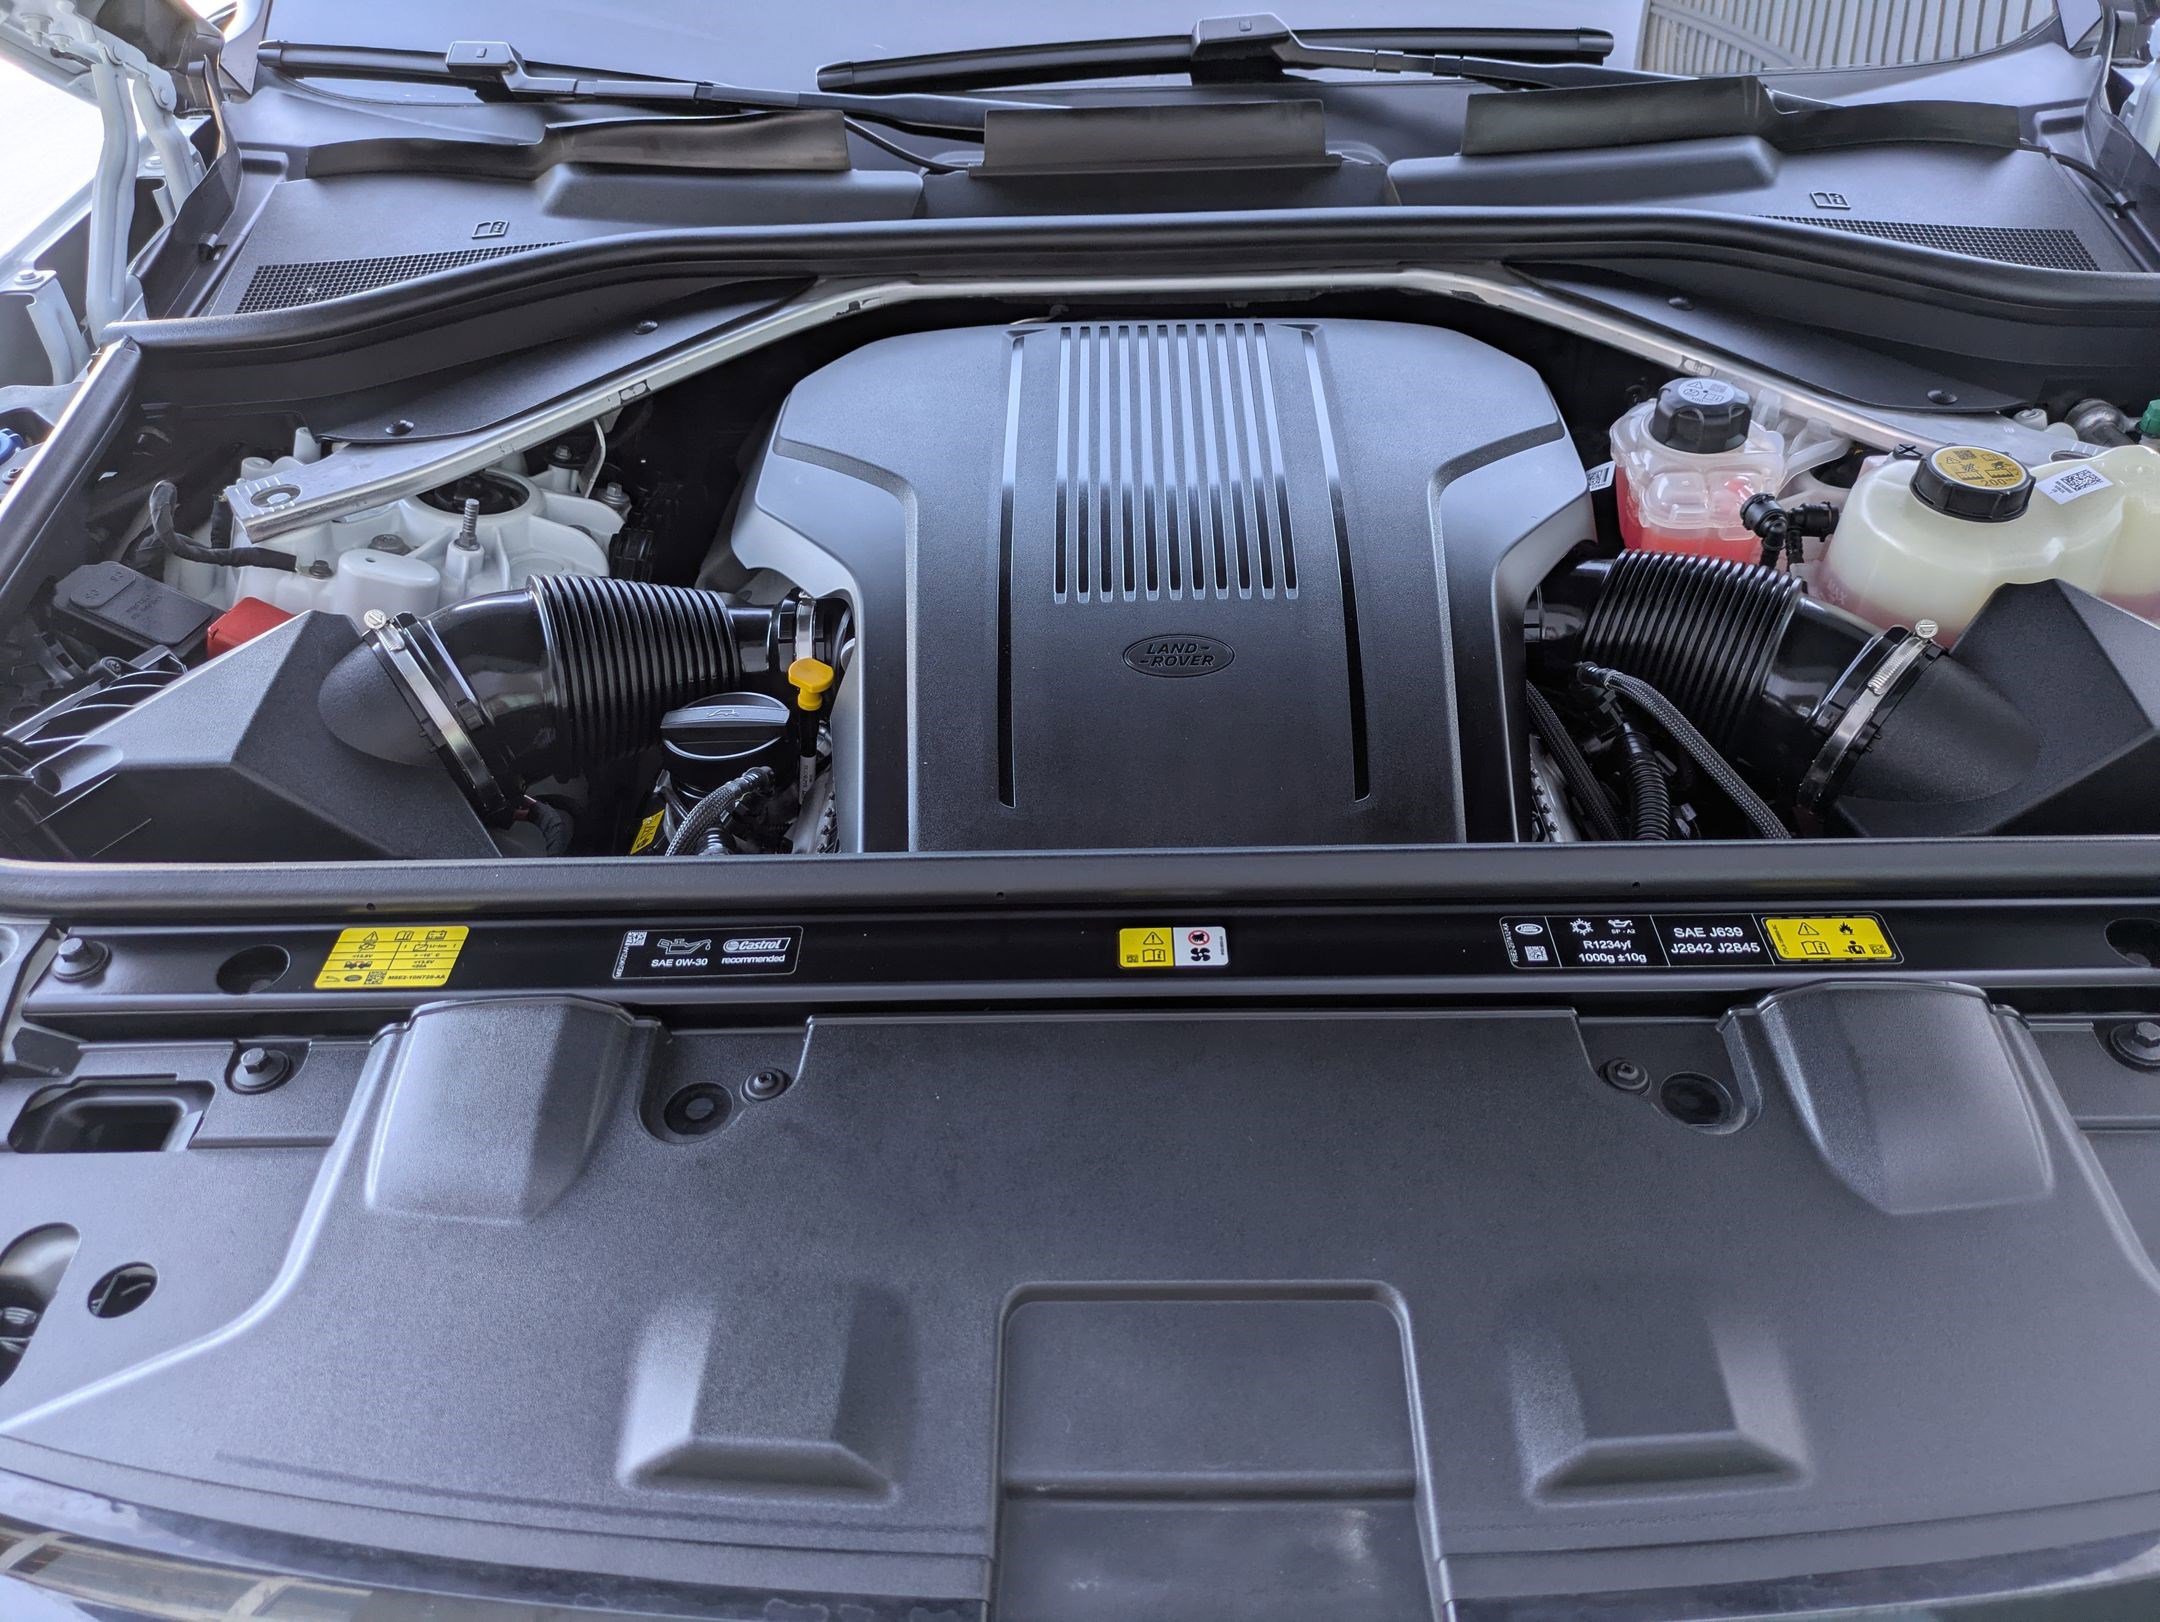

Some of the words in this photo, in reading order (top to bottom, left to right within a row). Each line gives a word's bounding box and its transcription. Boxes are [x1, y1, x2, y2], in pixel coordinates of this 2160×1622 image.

[1673, 927, 1706, 938] SAE
[1709, 926, 1744, 937] J639
[738, 939, 782, 950] Castrol
[1582, 939, 1632, 951] R1234yf
[1670, 943, 1715, 954] J2842
[1717, 942, 1761, 953] J2845
[650, 958, 674, 968] SAE
[675, 957, 709, 968] 0W-30
[721, 954, 786, 964] recommended
[1578, 952, 1616, 964] 1000g
[1617, 952, 1648, 964] ±10g
